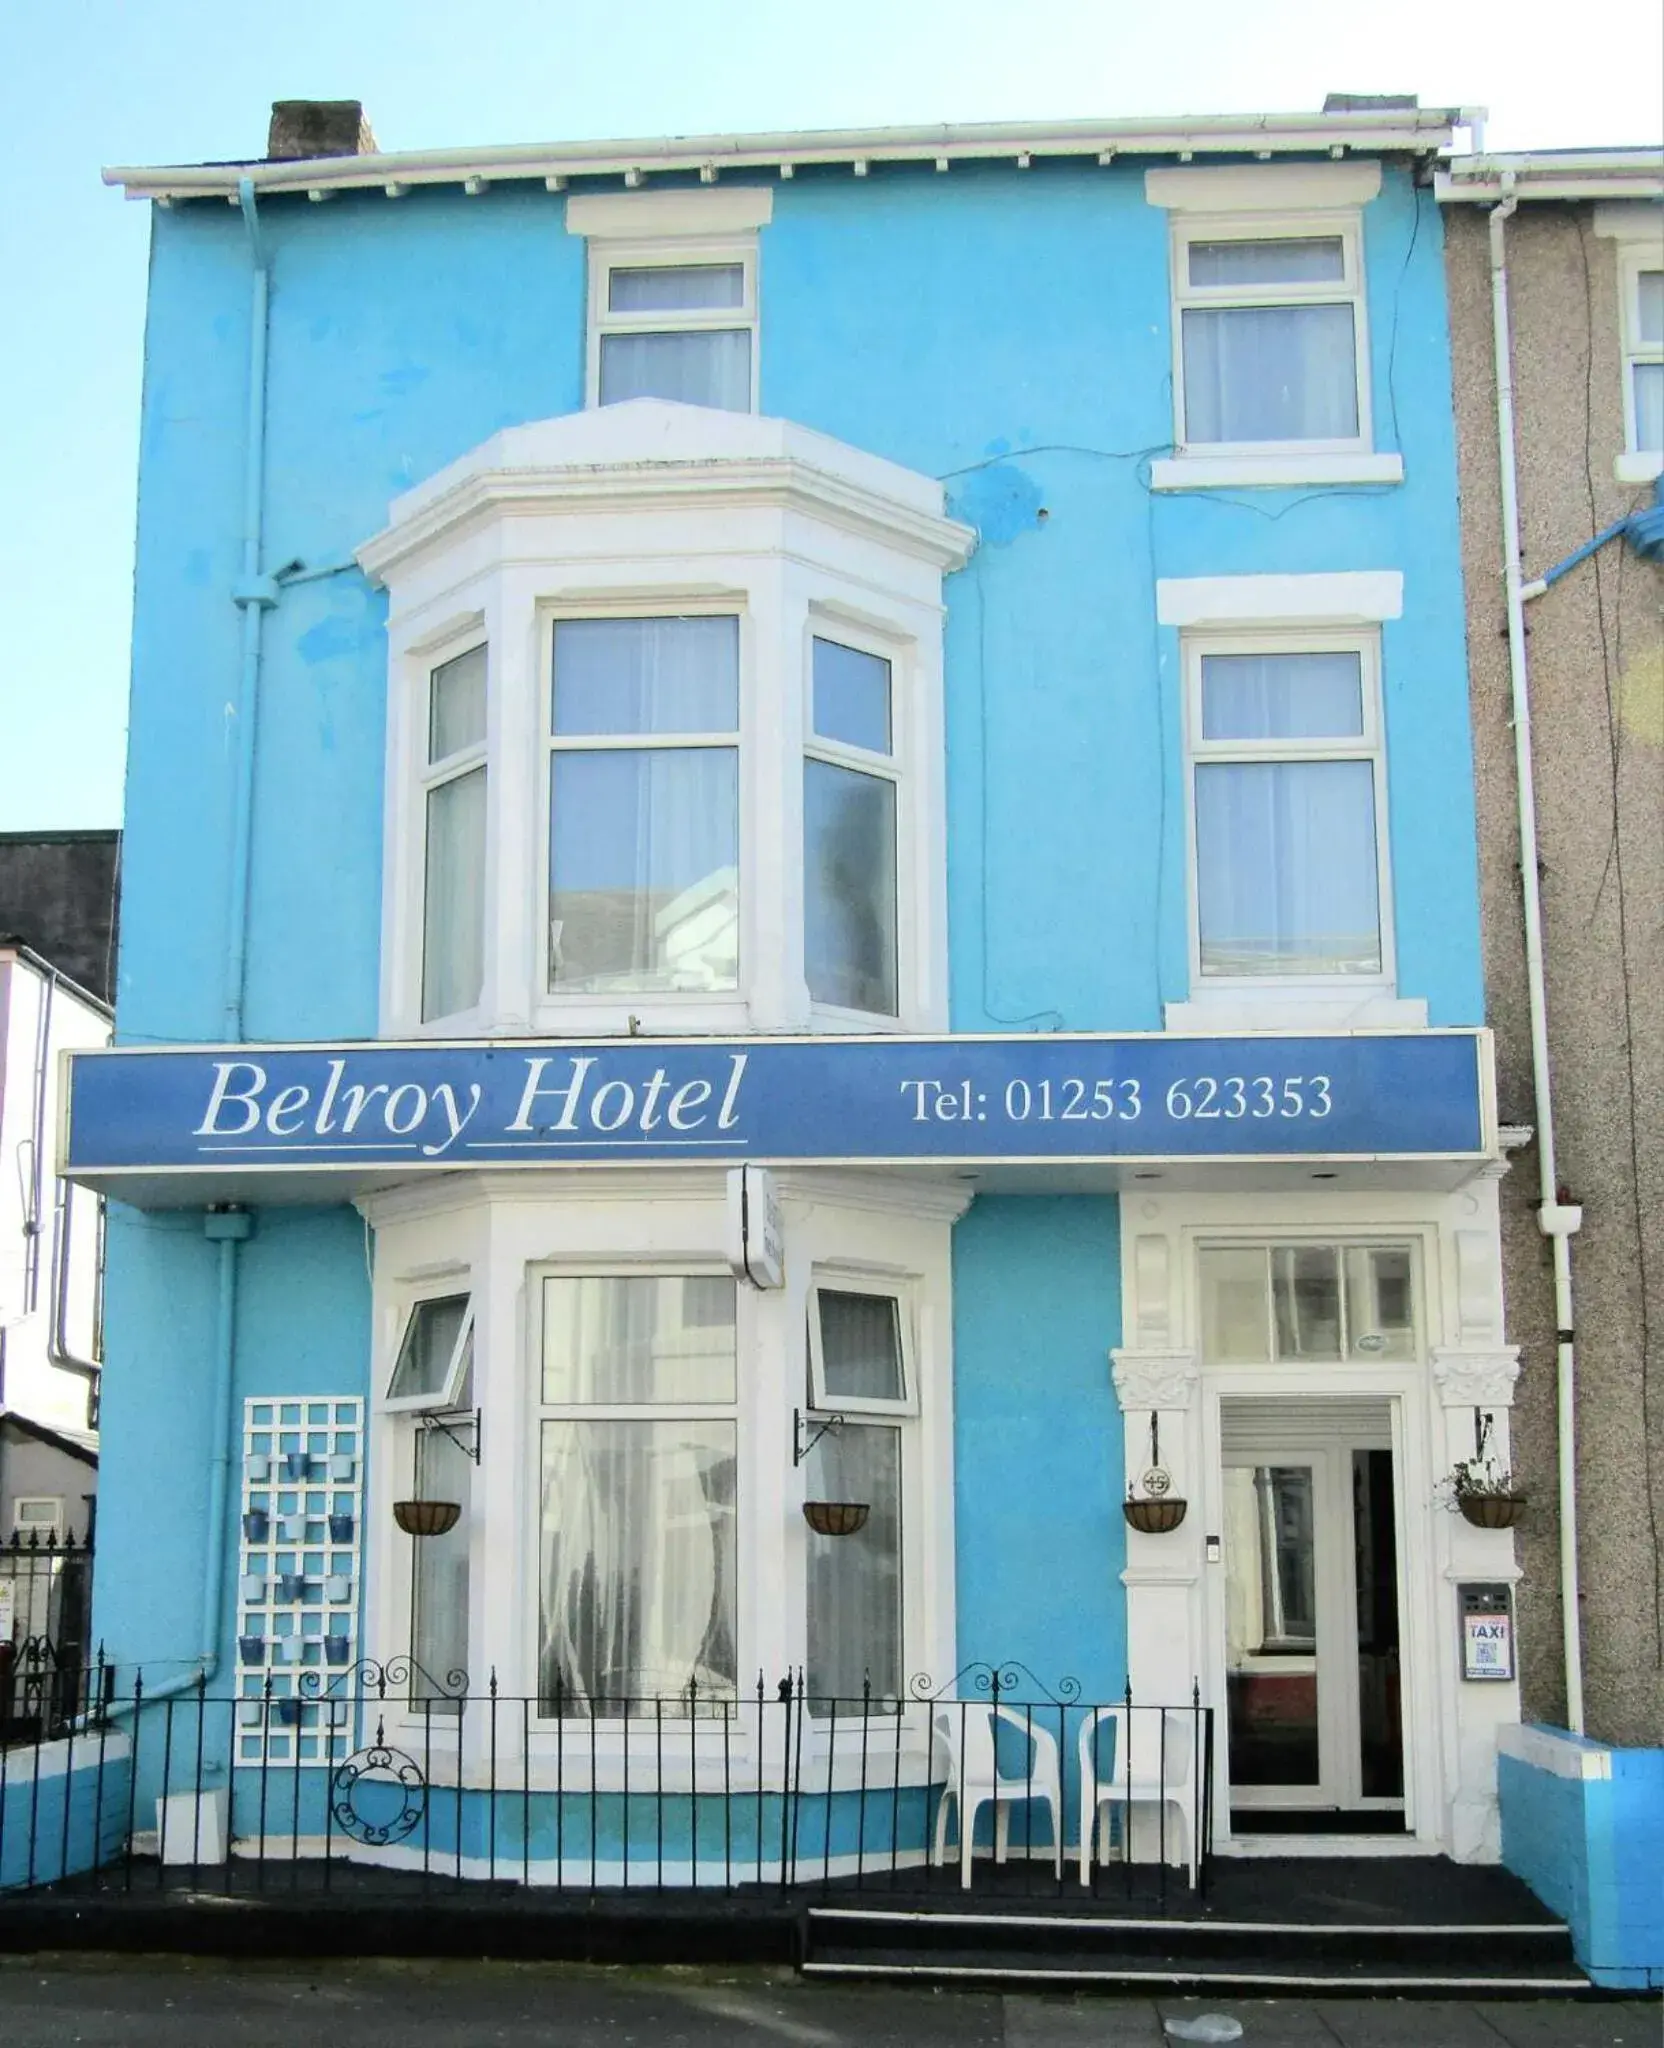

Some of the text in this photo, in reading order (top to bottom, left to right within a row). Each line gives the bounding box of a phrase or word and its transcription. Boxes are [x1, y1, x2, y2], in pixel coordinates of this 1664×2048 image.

[192, 1054, 749, 1156] Belroy Hotel
[900, 1075, 1333, 1121] Tel: 01253 623353
[1471, 1625, 1505, 1639] TAXI
